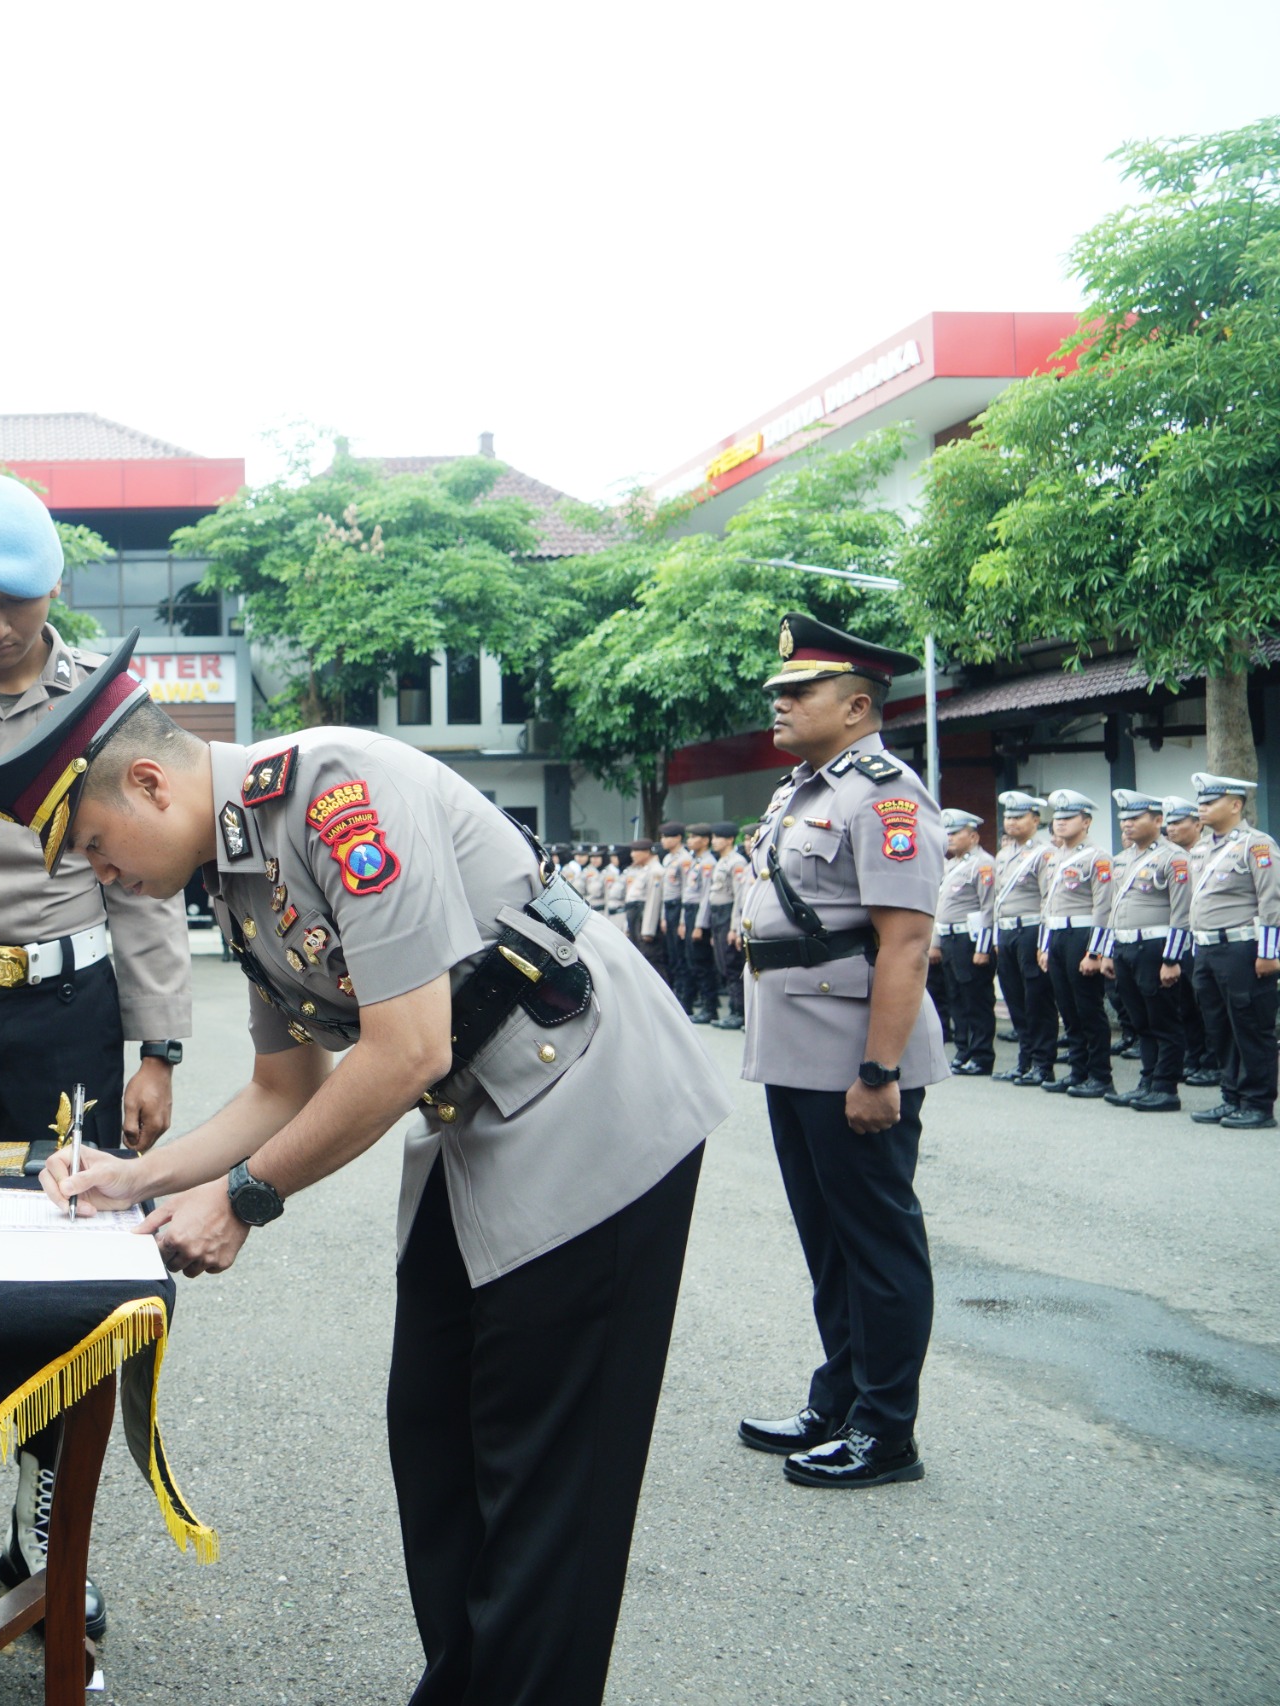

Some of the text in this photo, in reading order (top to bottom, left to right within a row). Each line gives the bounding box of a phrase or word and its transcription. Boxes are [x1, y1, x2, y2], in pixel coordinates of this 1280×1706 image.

[824, 339, 922, 413] DHARAKA
[309, 784, 363, 820] POLRES
[317, 792, 364, 822] PONOROGO
[877, 800, 915, 810] POLRES
[328, 813, 373, 839] JAWA TIMUR
